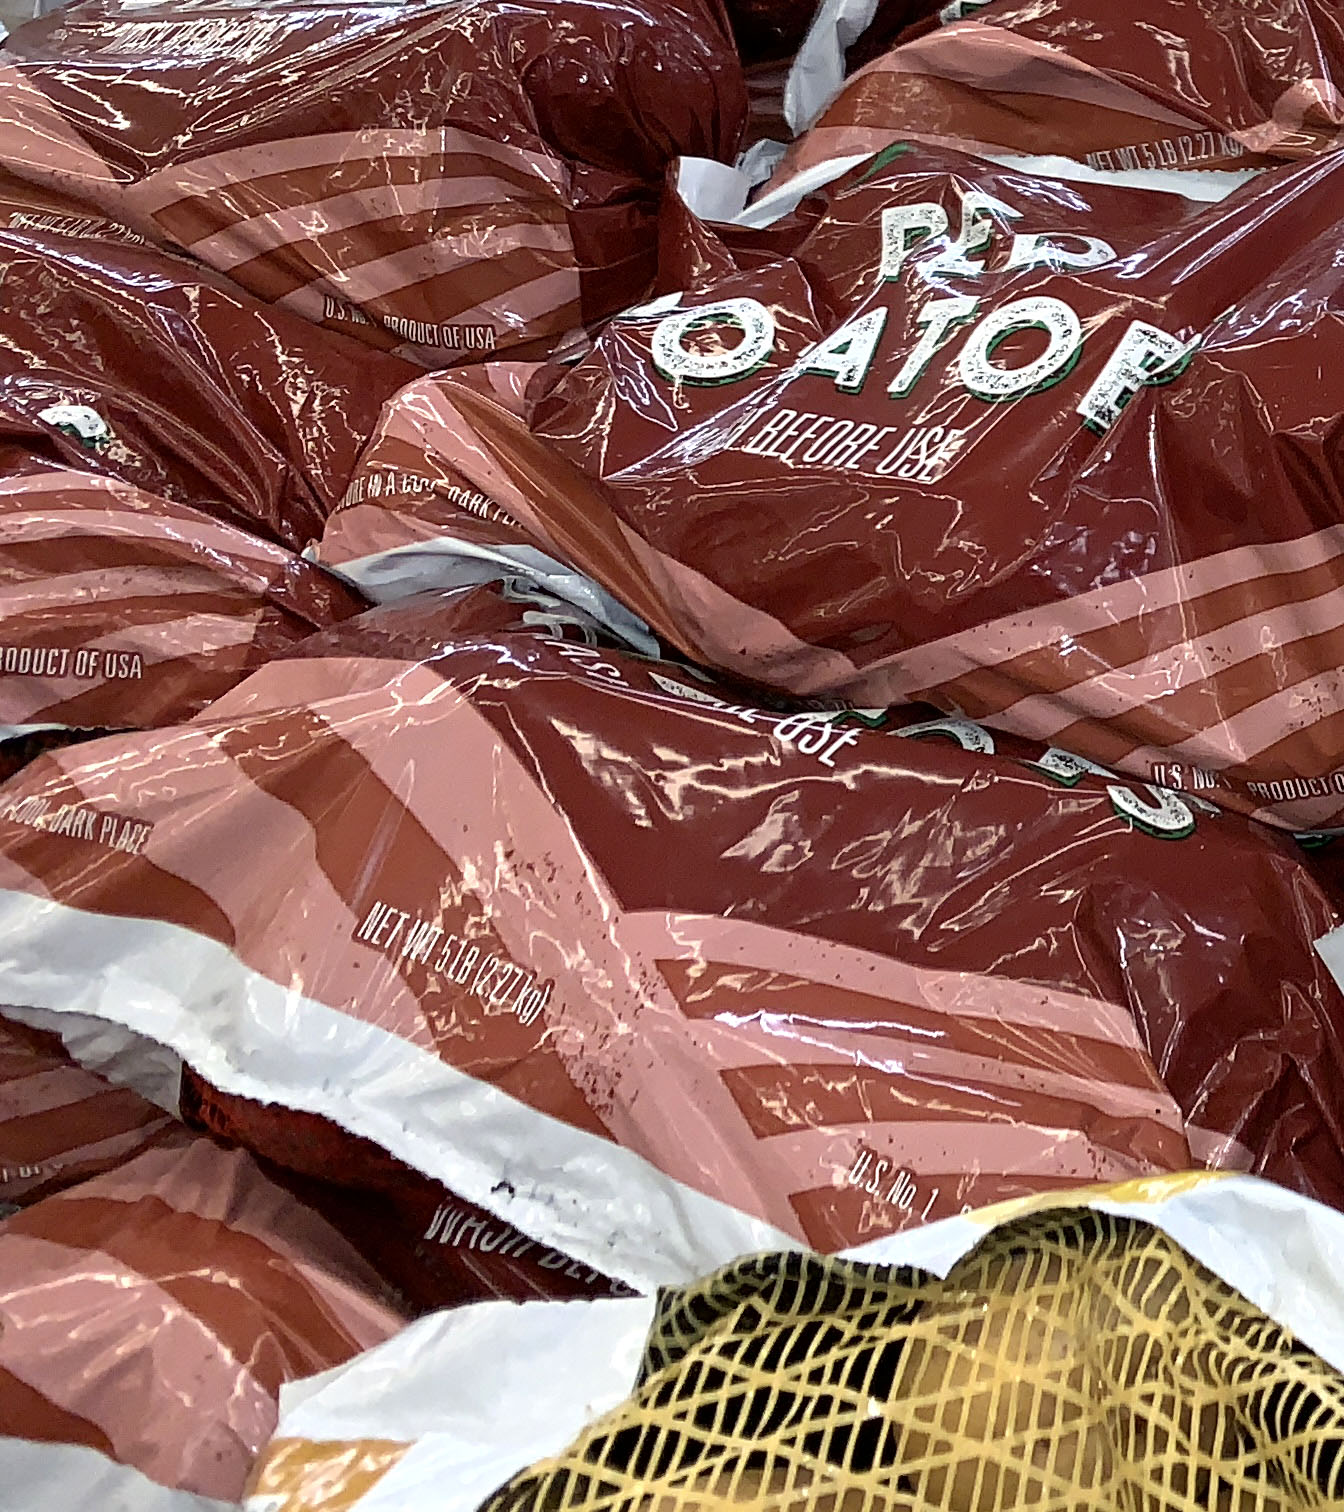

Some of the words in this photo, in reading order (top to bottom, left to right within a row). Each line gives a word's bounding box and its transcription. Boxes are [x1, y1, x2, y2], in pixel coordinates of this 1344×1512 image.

[442, 325, 461, 349] OF
[463, 326, 497, 351] USA
[756, 407, 895, 472] BEFORE
[875, 424, 965, 484] USE
[75, 649, 99, 677] OF
[105, 652, 142, 680] USA
[1153, 763, 1188, 790] U.S.
[1246, 775, 1329, 801] PRODUCT
[98, 815, 152, 856] PLACE
[358, 900, 411, 949] NET
[402, 918, 445, 965] WT
[434, 934, 458, 973] 5
[468, 952, 524, 1005] (2.27
[511, 974, 551, 1027] kg)
[849, 1150, 889, 1197] U.S.
[885, 1170, 917, 1211] No.
[920, 1187, 940, 1221] 1
